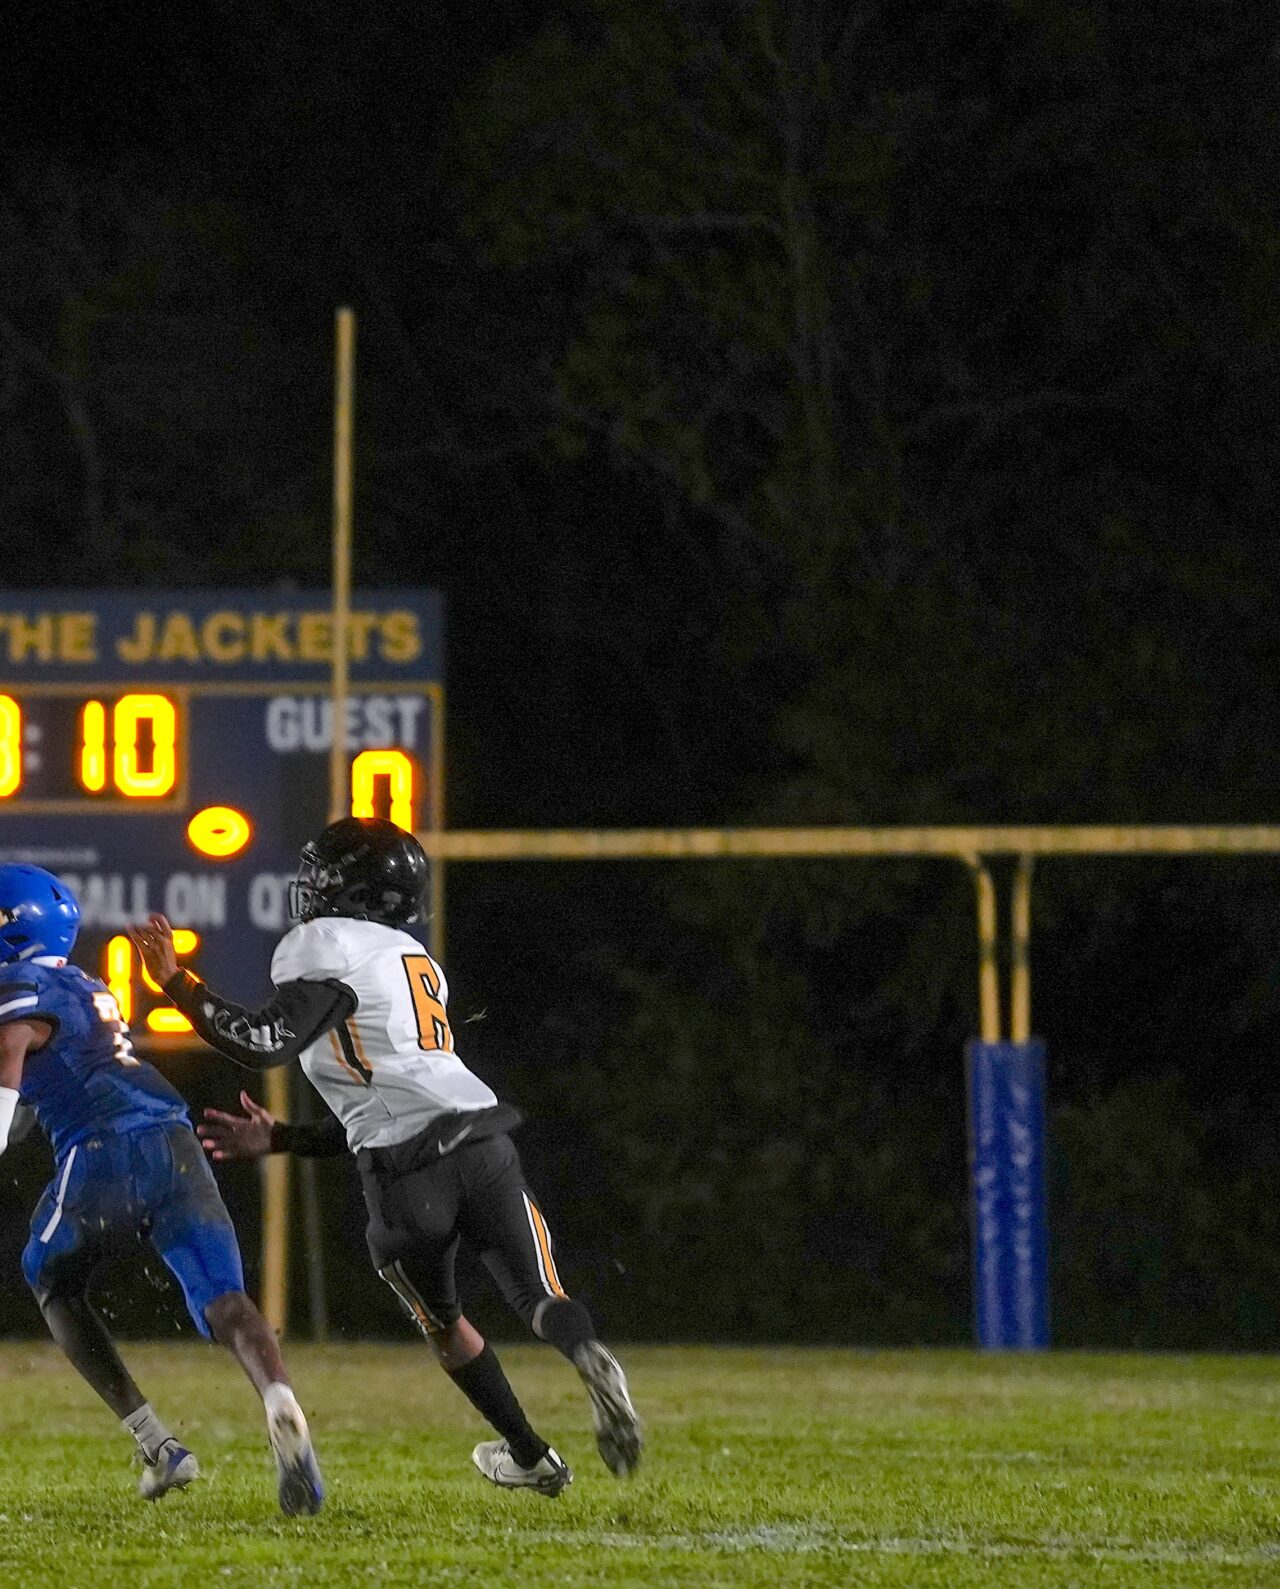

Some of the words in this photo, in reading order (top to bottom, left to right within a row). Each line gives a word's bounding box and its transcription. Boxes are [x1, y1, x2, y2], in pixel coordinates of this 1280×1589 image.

[116, 610, 421, 664] JACKETS
[266, 697, 422, 752] GUEST
[166, 872, 227, 927] ON
